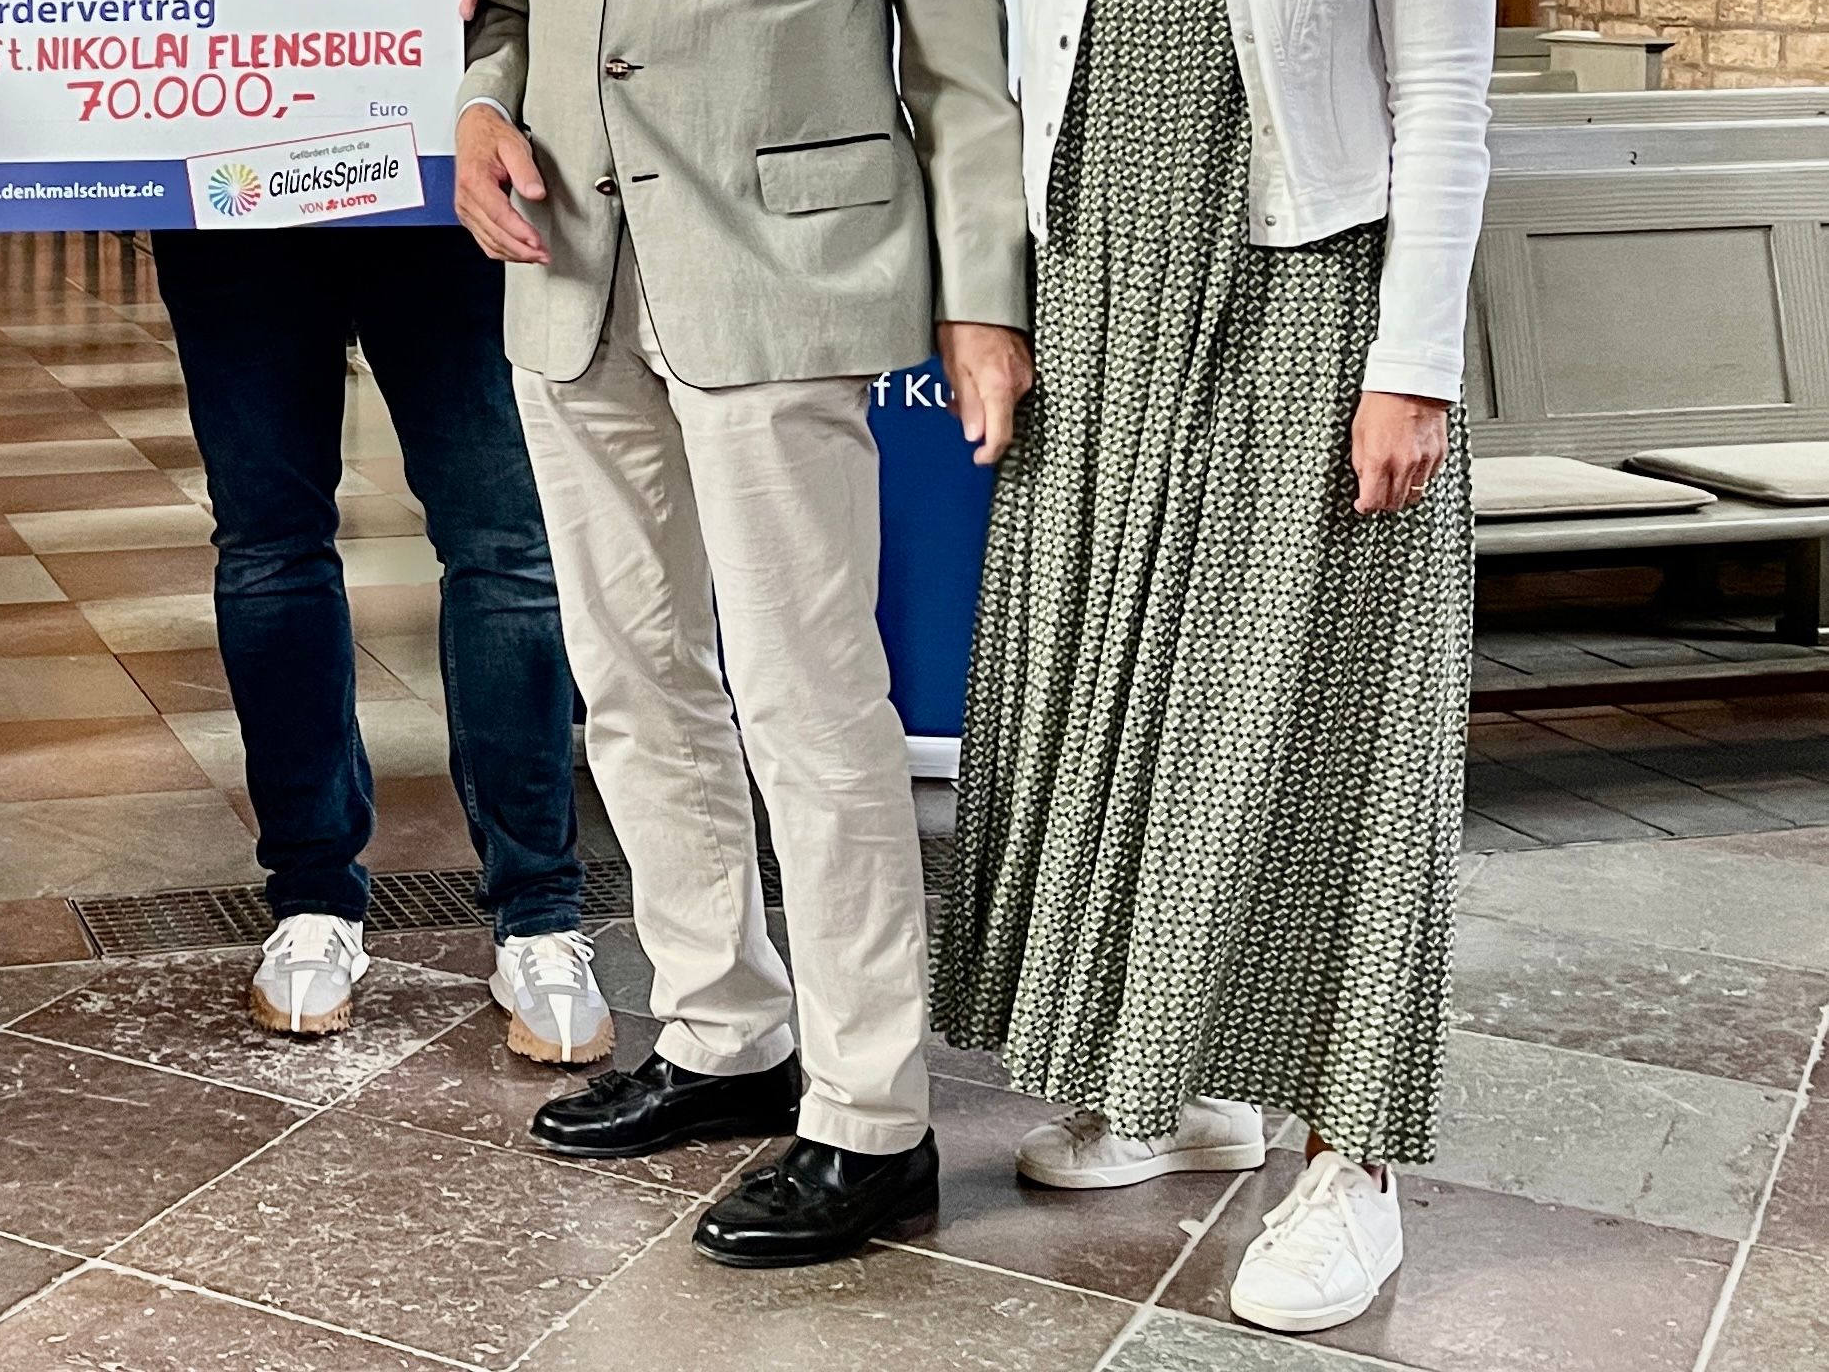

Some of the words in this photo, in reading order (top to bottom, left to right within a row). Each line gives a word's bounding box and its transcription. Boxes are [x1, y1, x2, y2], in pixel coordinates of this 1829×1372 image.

[208, 29, 423, 70] FLENSBURG
[66, 71, 316, 122] 70.000,-
[369, 101, 409, 118] Euro
[331, 143, 356, 154] durch
[357, 140, 371, 150] die
[269, 154, 400, 198] GlücksSpirale
[299, 200, 324, 215] VON
[340, 193, 378, 208] LOTTO
